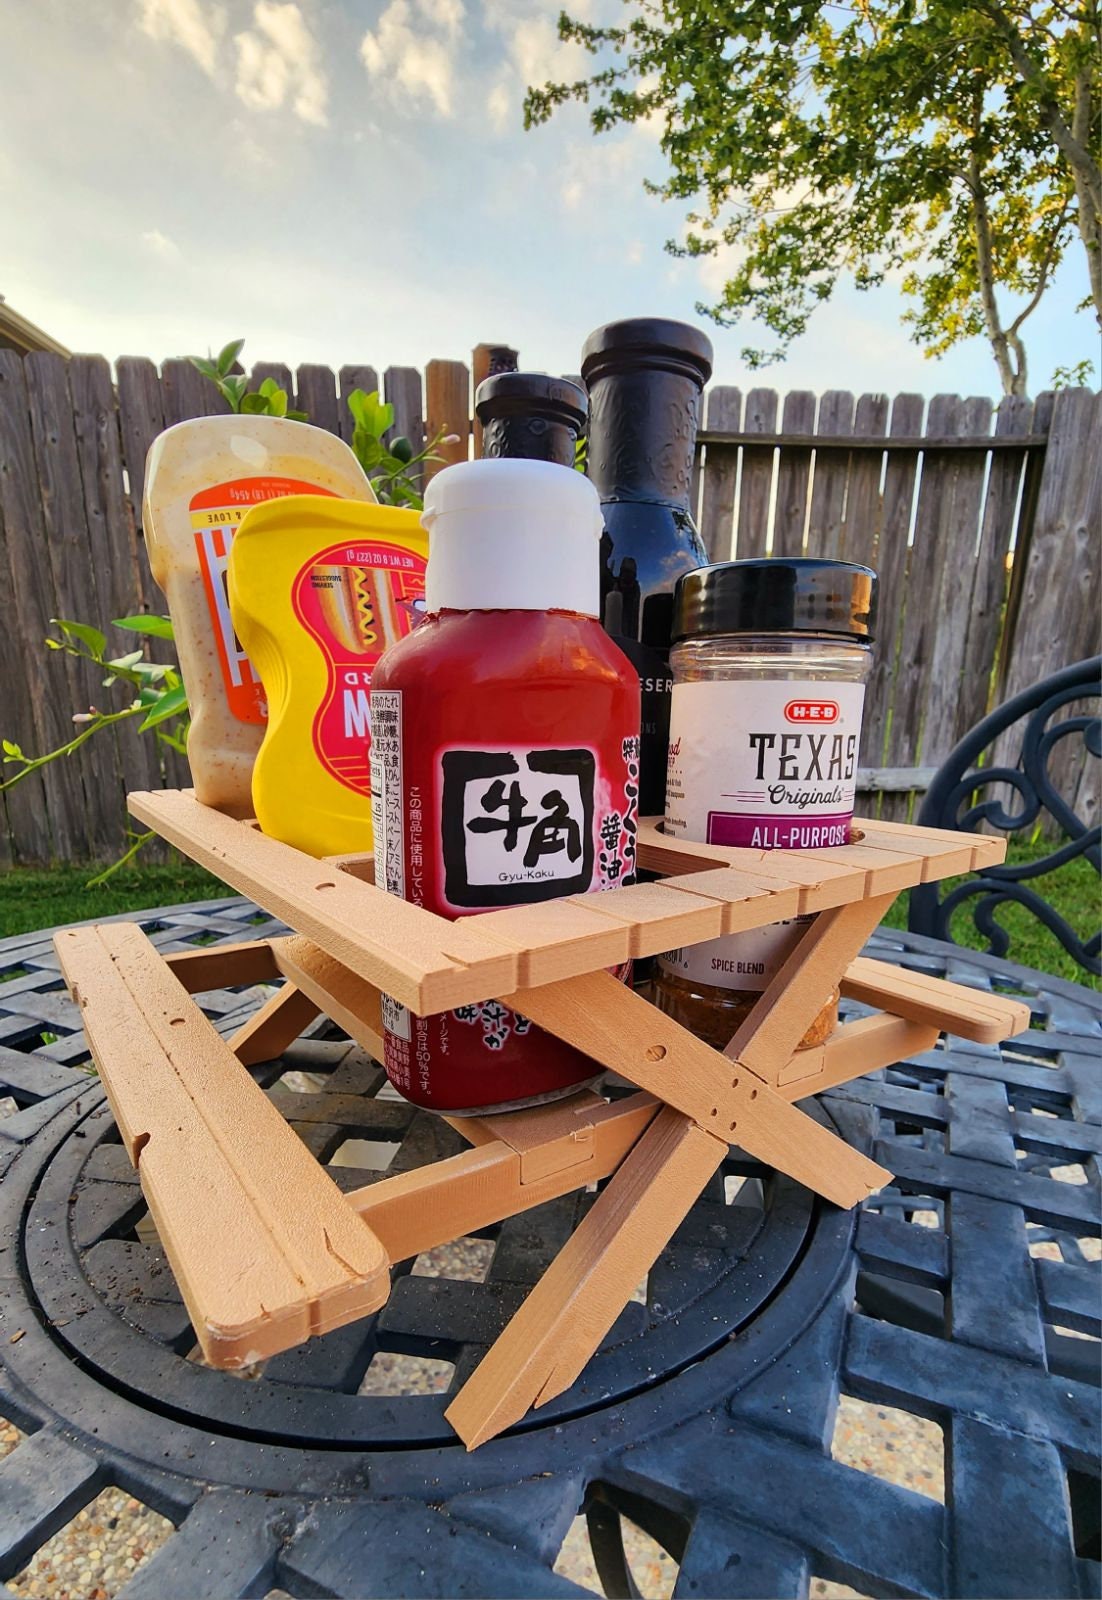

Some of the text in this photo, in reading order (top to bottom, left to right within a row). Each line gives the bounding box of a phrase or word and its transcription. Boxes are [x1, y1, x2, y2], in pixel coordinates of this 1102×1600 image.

[207, 511, 232, 523] LOVE
[373, 553, 382, 563] OZ
[402, 558, 414, 568] NET
[749, 733, 856, 781] TEXAS
[768, 784, 843, 809] Originals
[466, 779, 582, 868] 牛角
[751, 824, 847, 848] ALL-PURPOSE
[498, 870, 555, 883] Gyu-Kaku
[711, 958, 765, 975] SPICE BLEND
